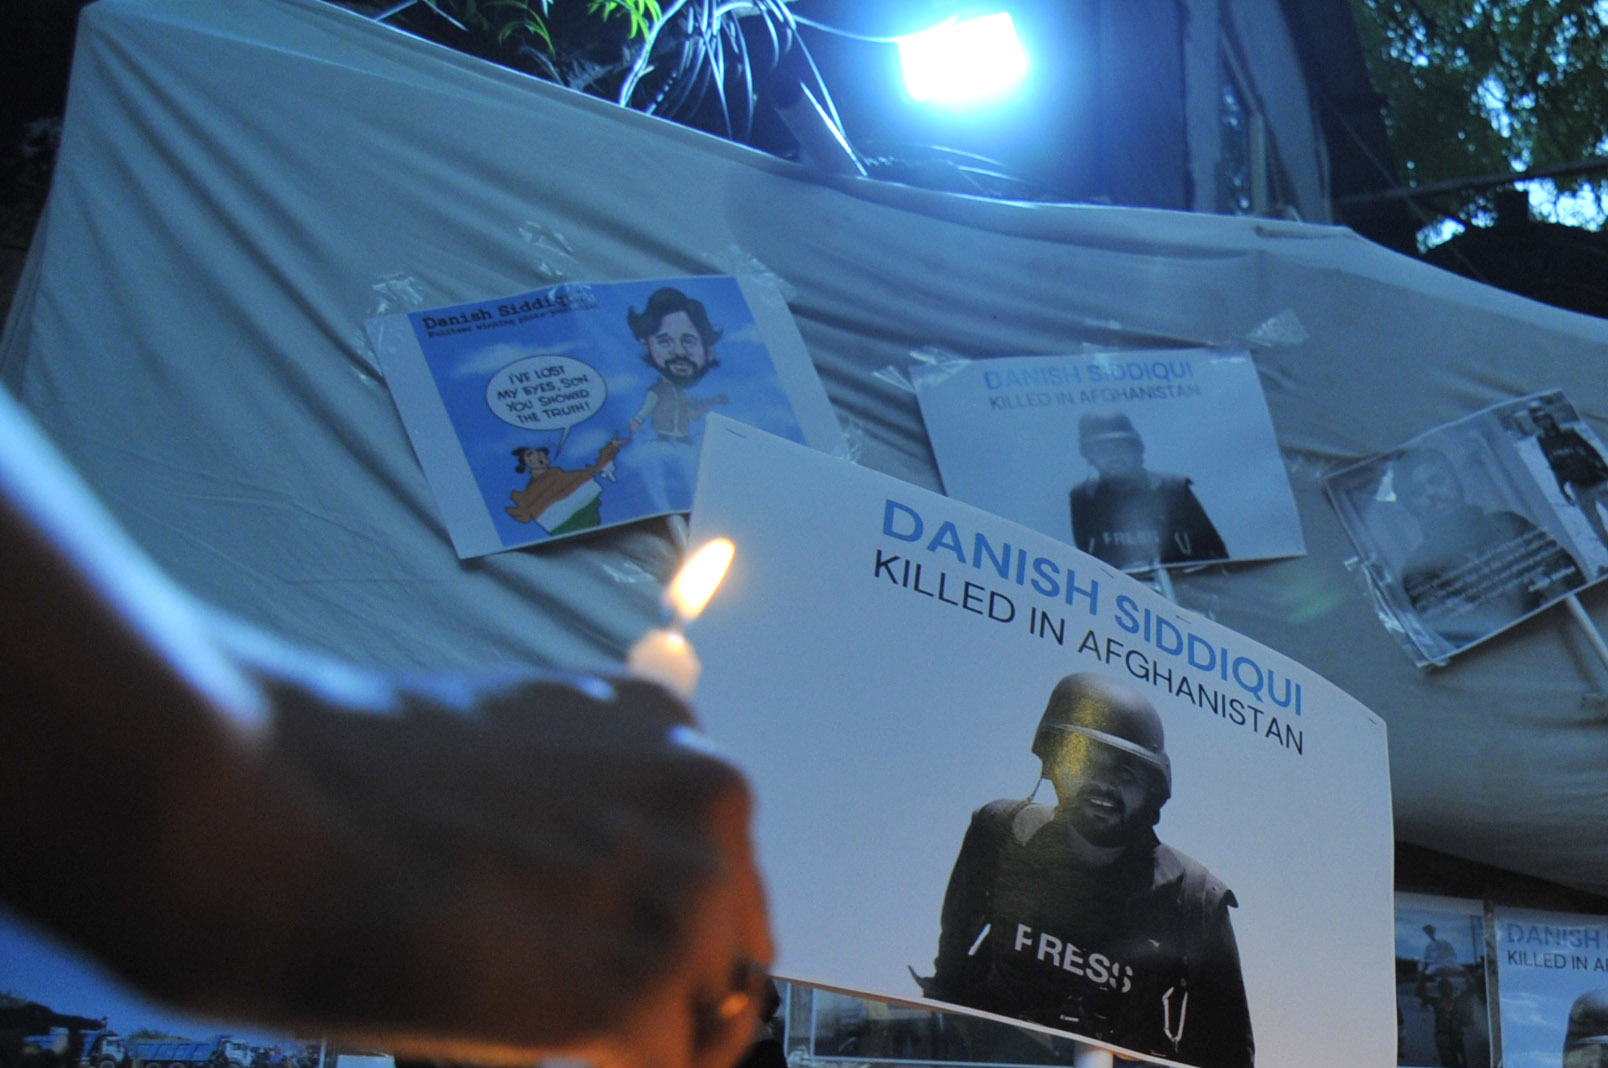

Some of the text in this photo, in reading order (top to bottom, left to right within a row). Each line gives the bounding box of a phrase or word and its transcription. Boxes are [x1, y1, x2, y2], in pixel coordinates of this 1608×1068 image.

[422, 307, 493, 330] Danish
[498, 295, 584, 317] Siddiq
[535, 365, 566, 379] LOST
[984, 360, 1194, 391] DANISH SIDDIQUI
[497, 388, 518, 400] MY
[506, 401, 534, 412] YOU
[989, 384, 1201, 411] KILLED IN AFGHANISTAN
[516, 402, 591, 424] THE TRUTH!
[881, 498, 1302, 717] DANISH SIDDIQUI
[873, 549, 1304, 756] KILLED IN AFGHANISTAN
[1506, 922, 1601, 949] DANISH
[1507, 950, 1567, 969] KILLED
[1571, 955, 1589, 971] IN
